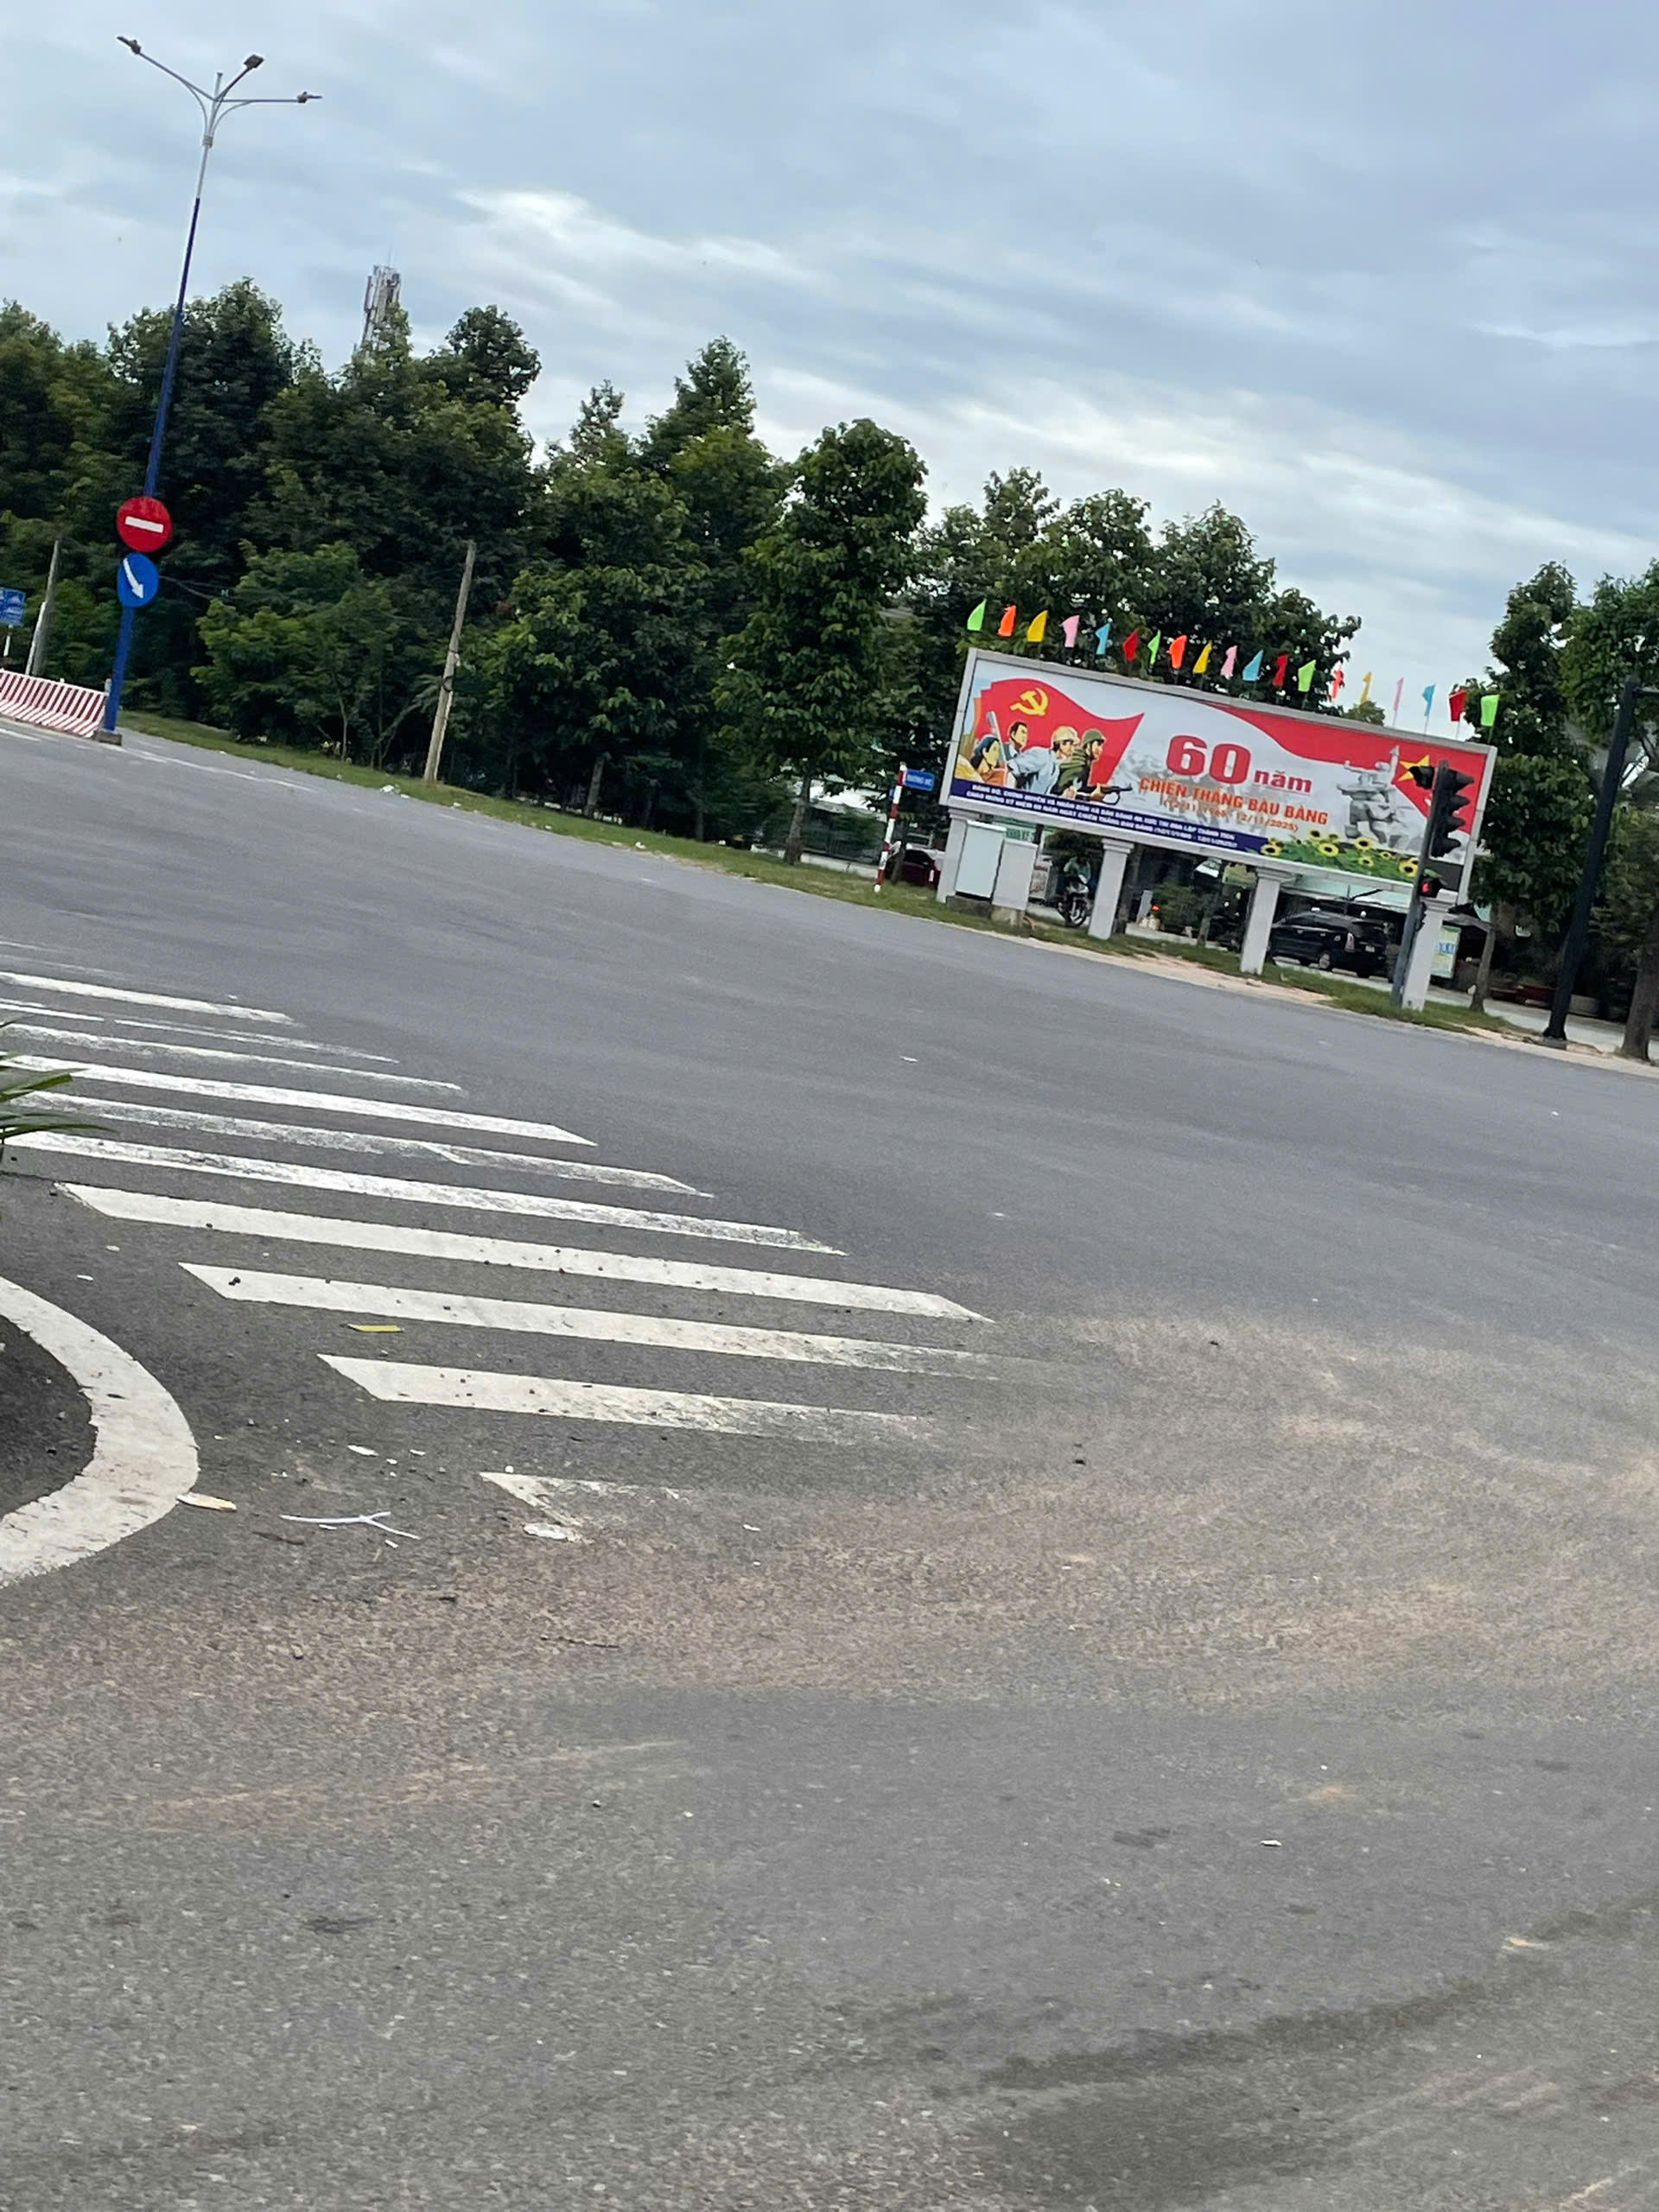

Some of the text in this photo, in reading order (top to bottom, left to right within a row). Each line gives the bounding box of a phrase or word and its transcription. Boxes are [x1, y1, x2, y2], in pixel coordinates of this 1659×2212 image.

[1166, 734, 1313, 793] 60 năm
[1139, 777, 1187, 797] CHIẾN
[1248, 796, 1281, 816] BÀU
[1284, 804, 1329, 825] BÀNG
